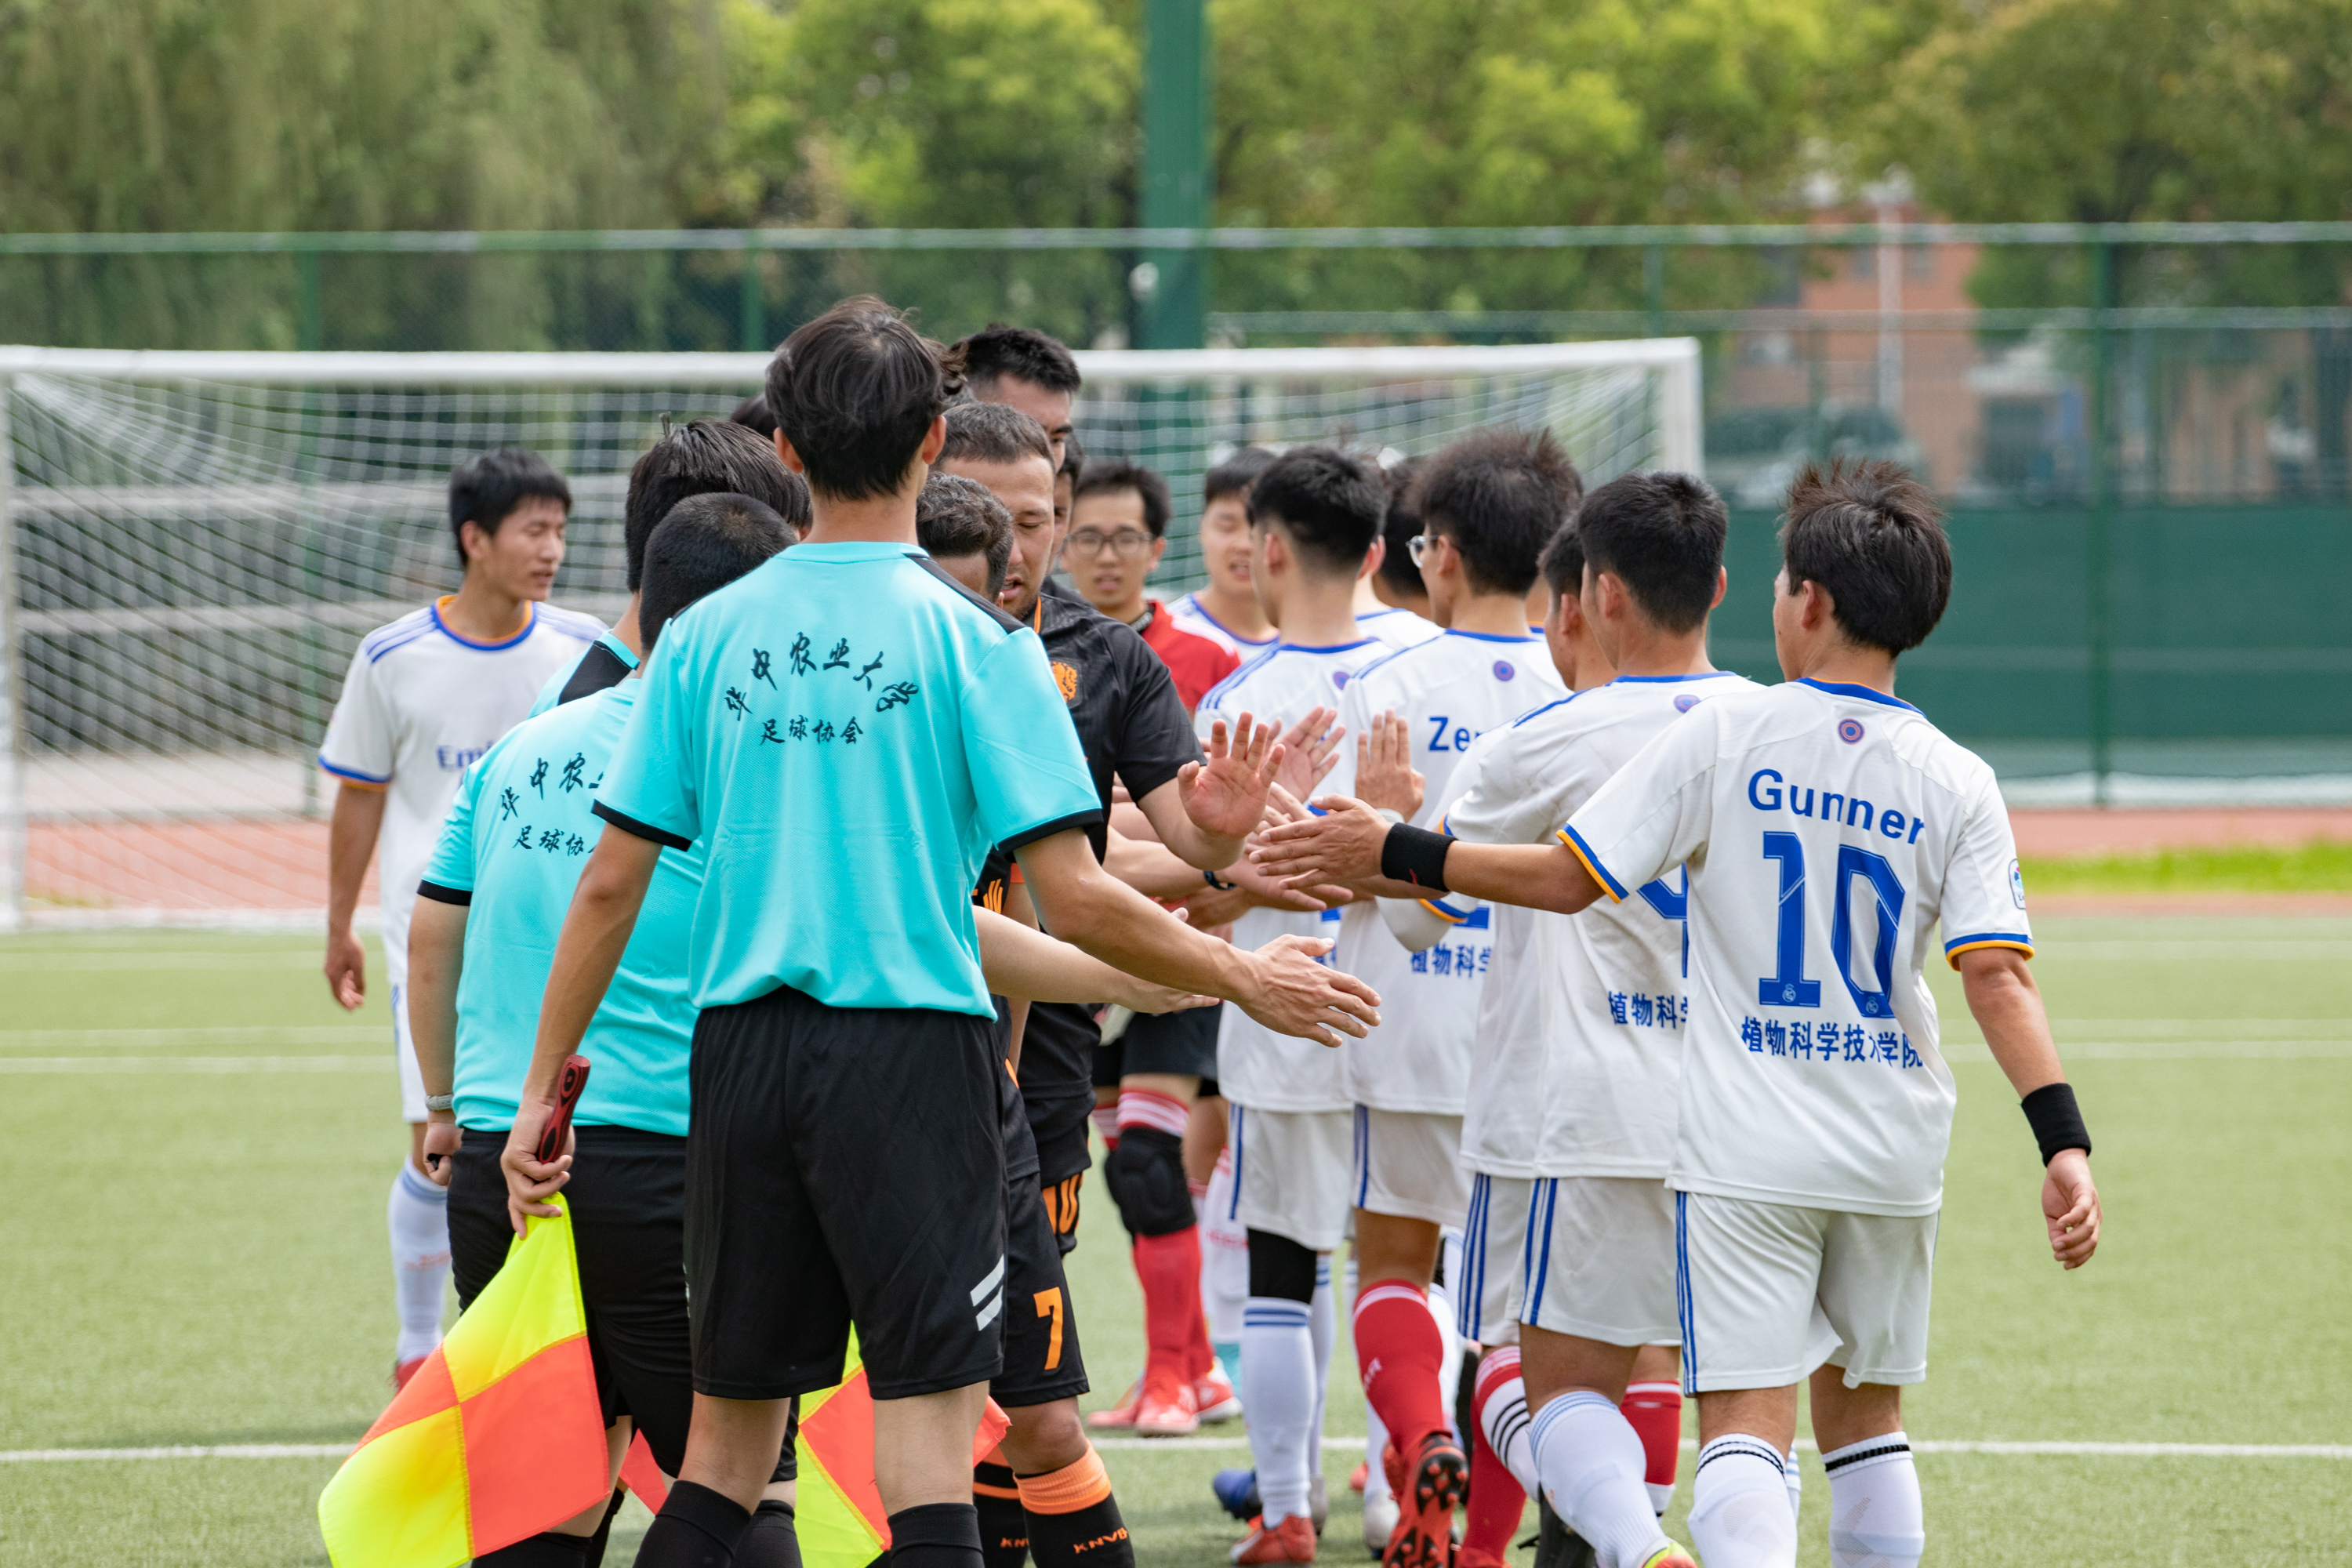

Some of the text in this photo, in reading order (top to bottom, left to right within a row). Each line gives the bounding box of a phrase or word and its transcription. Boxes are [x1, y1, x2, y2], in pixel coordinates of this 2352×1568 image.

[760, 714, 864, 746] 足球协会
[1428, 716, 1481, 753] Ze
[500, 751, 604, 822] 华中农
[1748, 768, 1926, 845] Gunner
[512, 824, 597, 856] 足球协
[1759, 830, 1906, 1018] 10
[1033, 1287, 1064, 1370] 7
[1073, 1527, 1128, 1555] KNVB
